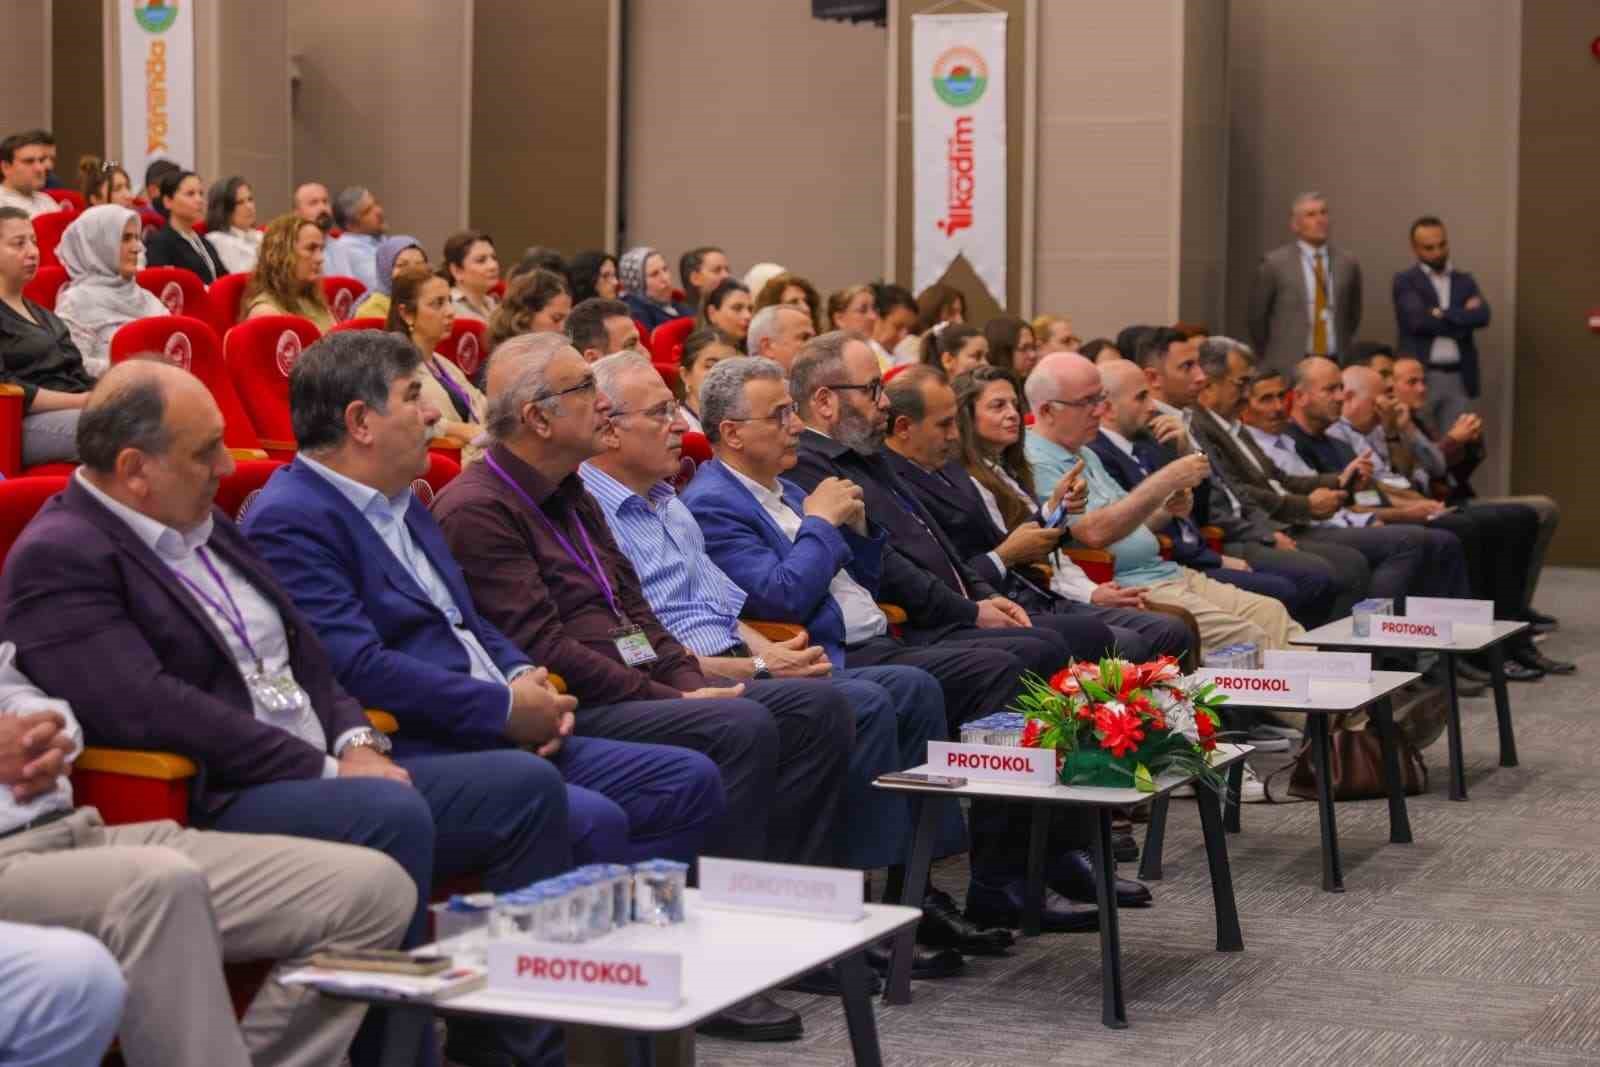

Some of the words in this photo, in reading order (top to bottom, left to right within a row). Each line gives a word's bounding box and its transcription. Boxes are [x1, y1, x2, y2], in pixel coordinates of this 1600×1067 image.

[1382, 622, 1438, 637] PROTOKOL
[1215, 676, 1290, 692] PROTOKOL
[947, 753, 1034, 773] PROTOKOL
[517, 955, 648, 987] PROTOKOL
